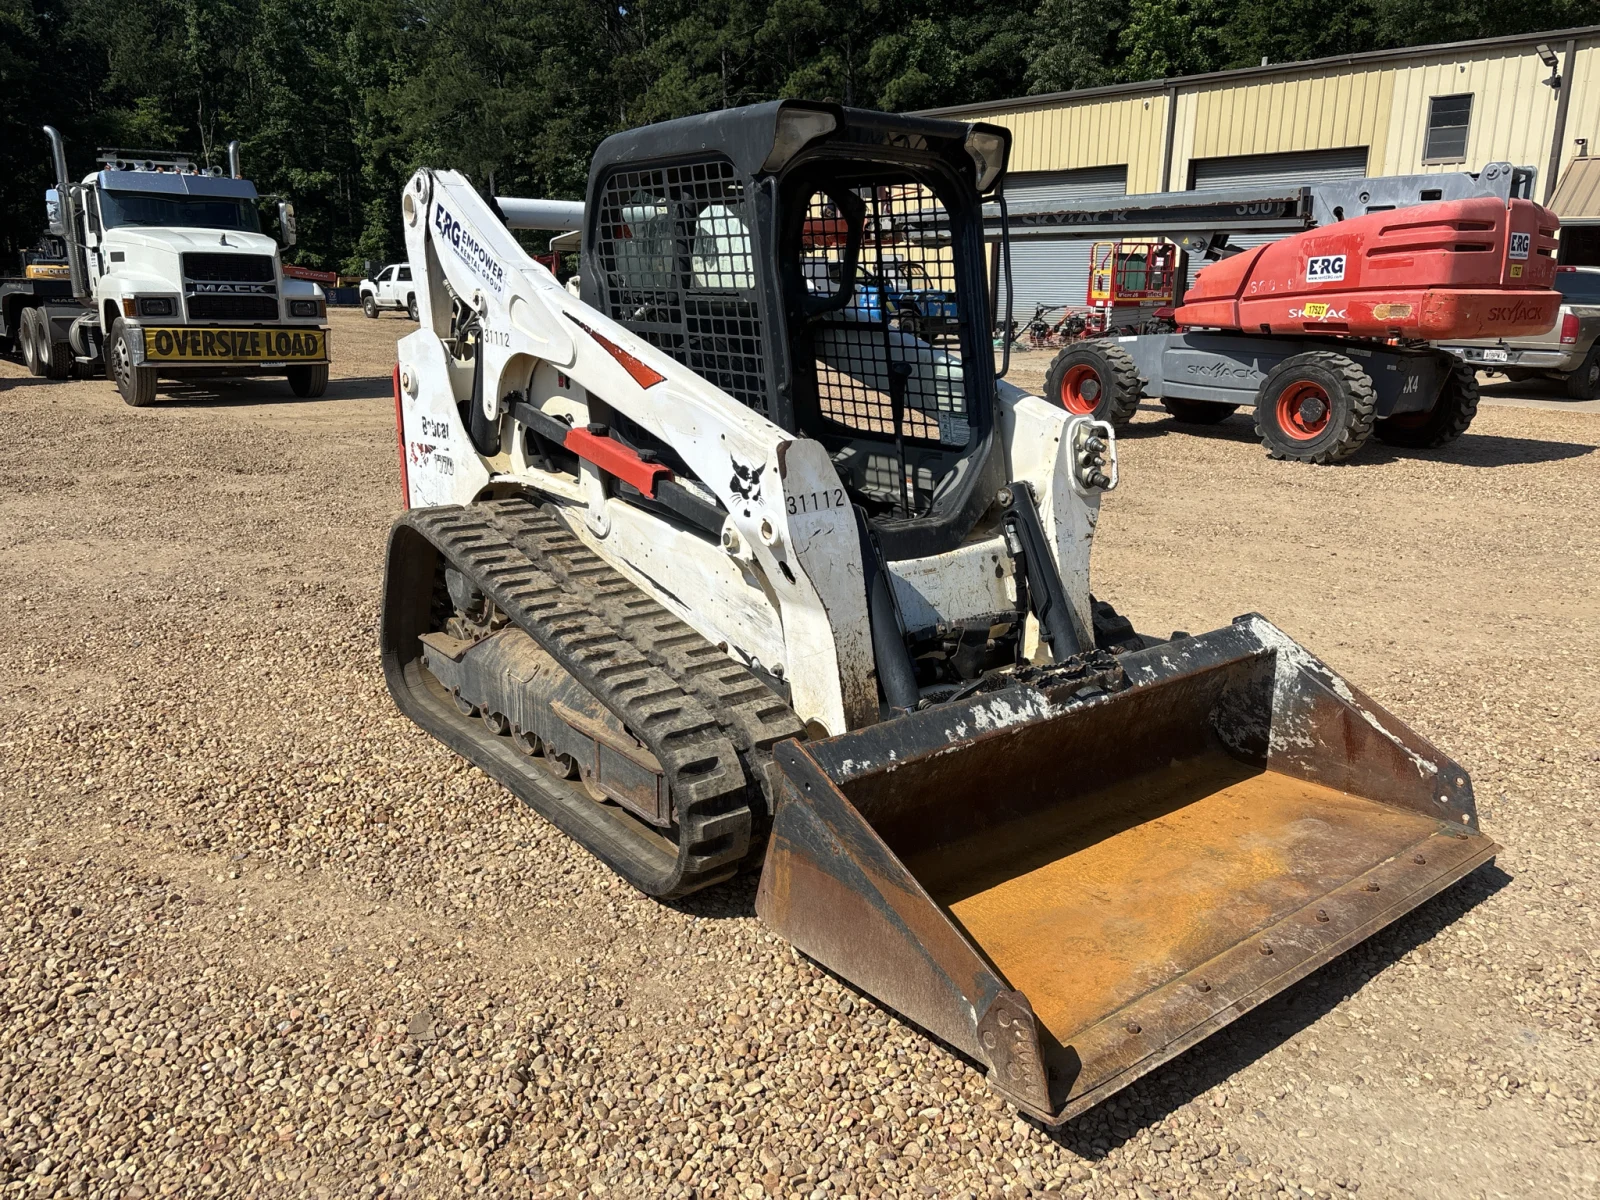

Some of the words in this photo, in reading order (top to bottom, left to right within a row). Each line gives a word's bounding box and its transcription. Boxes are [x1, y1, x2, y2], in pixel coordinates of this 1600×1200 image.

[435, 202, 461, 249] ERG
[1510, 234, 1529, 252] ERG
[461, 229, 504, 283] EMPOWER
[1308, 257, 1344, 275] ERG
[460, 245, 481, 272] RENTAL
[481, 269, 502, 293] GROUP
[196, 283, 266, 293] MACK
[1308, 304, 1326, 315] 17527
[1488, 300, 1543, 324] SKYJACK
[154, 329, 262, 357] OVERSIZE
[265, 332, 319, 357] LOAD
[484, 328, 511, 348] 31112
[1187, 362, 1259, 380] SKYJACK
[786, 488, 844, 515] 31112
